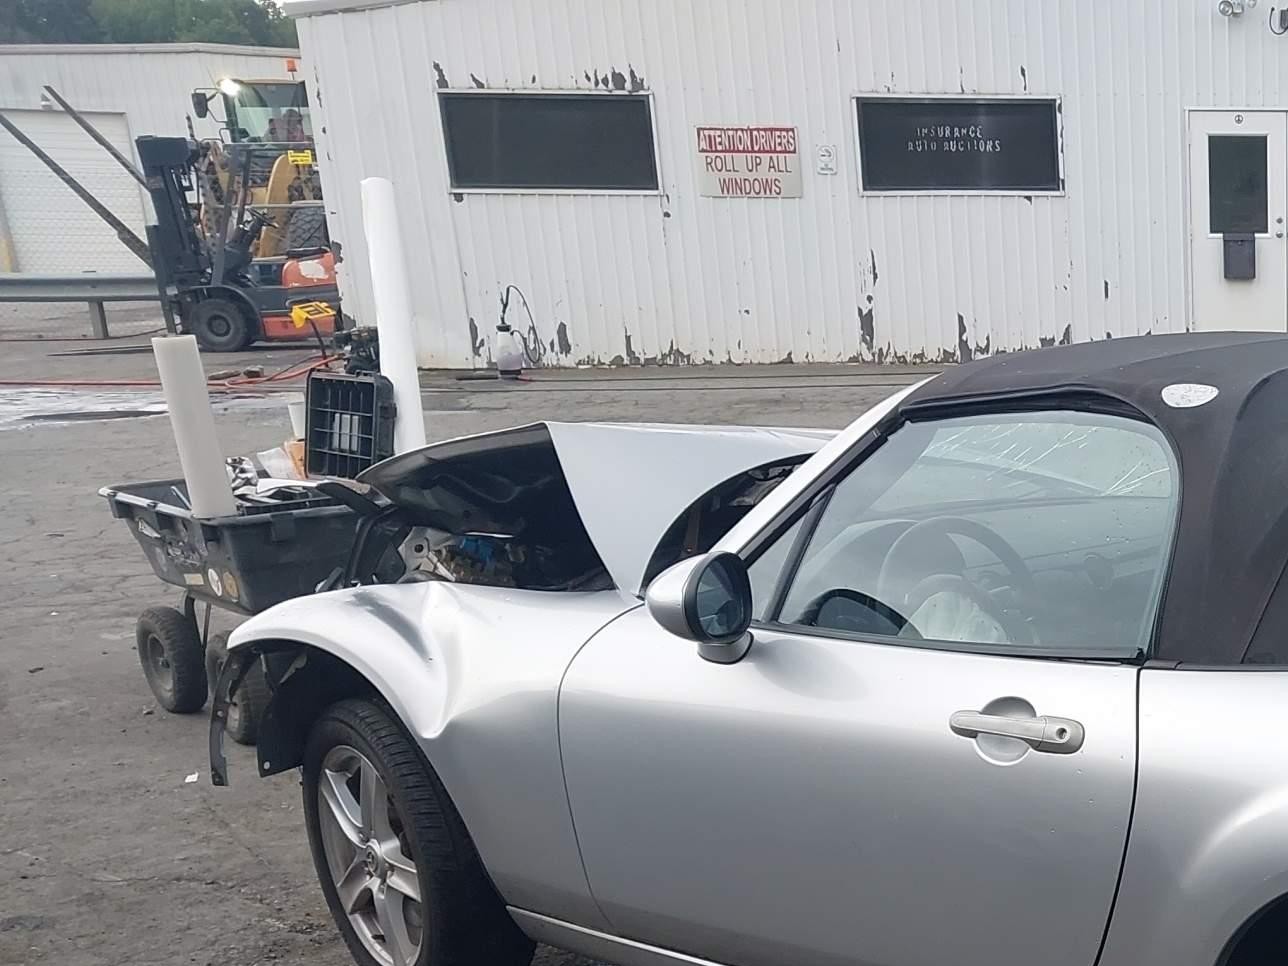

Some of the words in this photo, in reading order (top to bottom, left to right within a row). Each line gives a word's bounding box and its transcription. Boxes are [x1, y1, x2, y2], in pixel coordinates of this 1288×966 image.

[700, 129, 751, 152] ATTENTION
[752, 129, 795, 152] DRIVERS
[705, 154, 740, 173] ROLL
[745, 154, 763, 173] UP
[767, 155, 793, 173] ALL
[719, 177, 782, 196] WINDOWS
